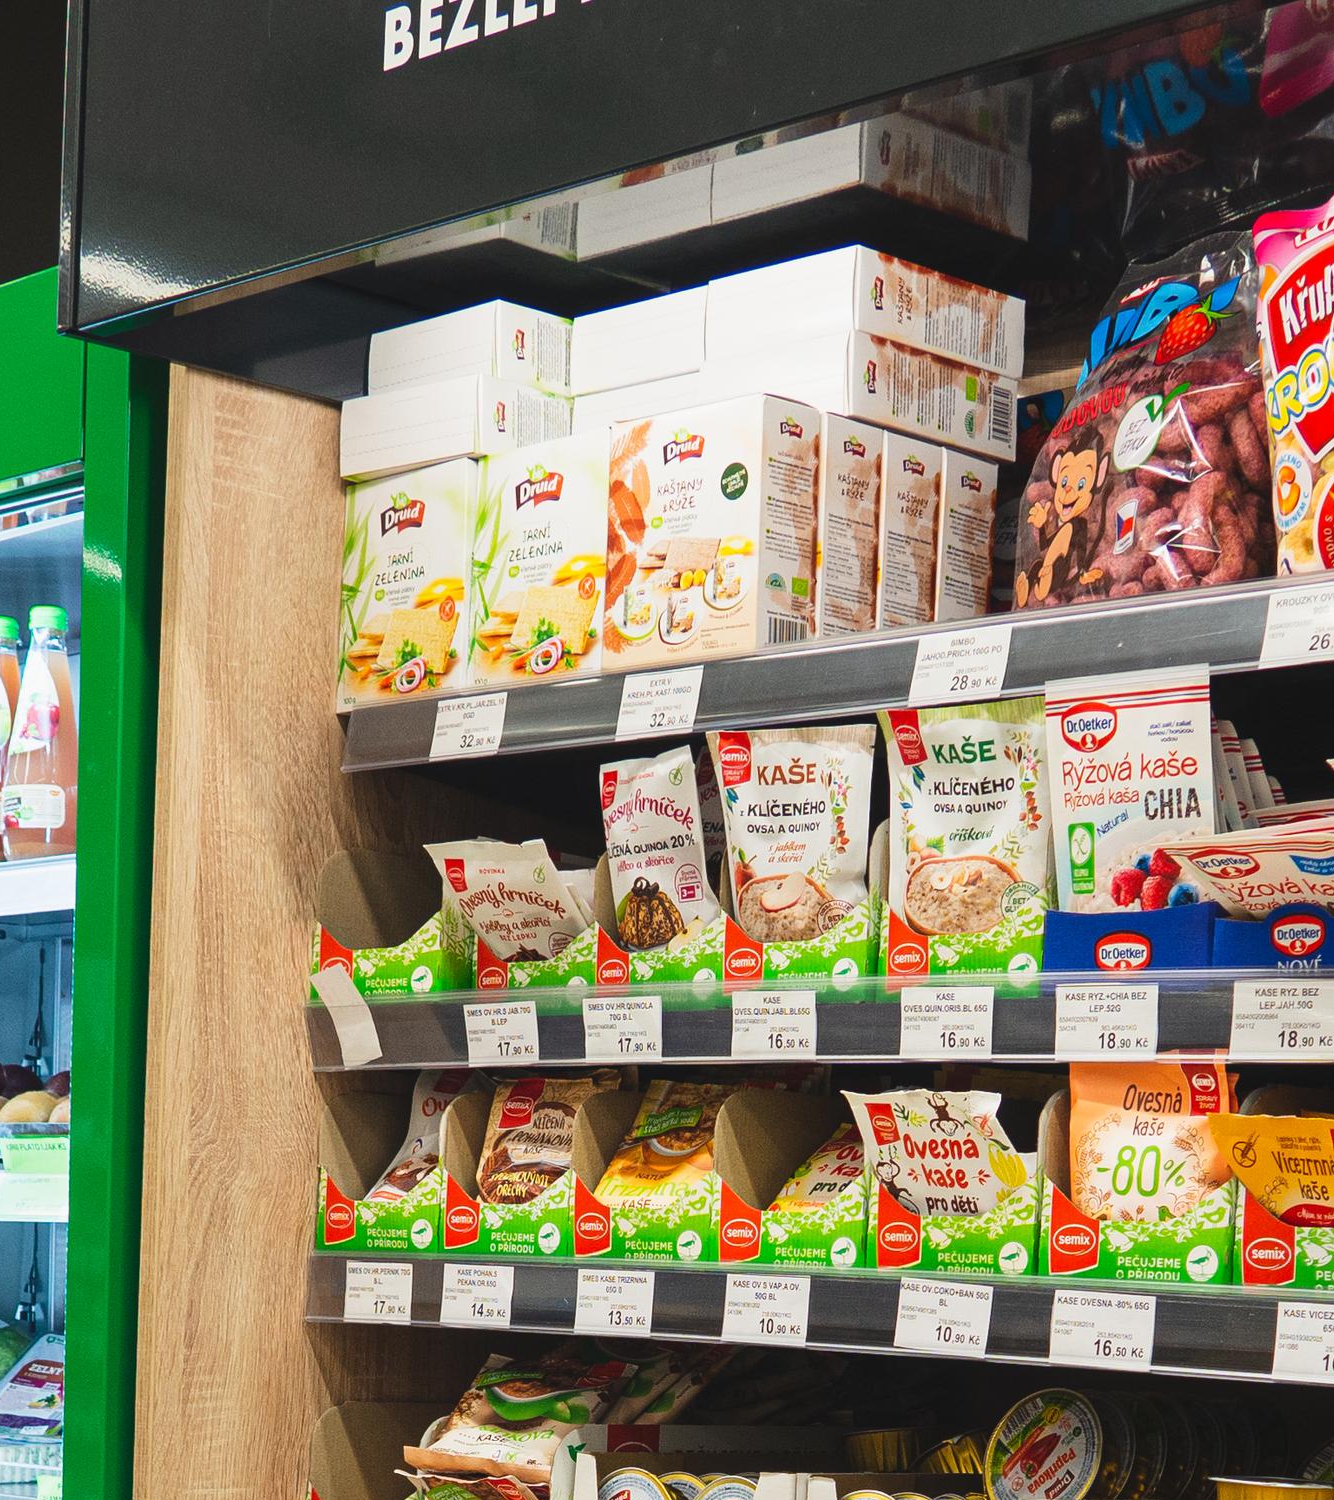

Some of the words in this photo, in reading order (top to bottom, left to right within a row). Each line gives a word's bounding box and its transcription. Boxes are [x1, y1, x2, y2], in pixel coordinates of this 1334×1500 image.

[521, 476, 559, 503] Druid
[1066, 716, 1112, 734] Dr.Oetker
[932, 739, 997, 765] KAŠE
[756, 761, 816, 787] KAŠE
[1062, 761, 1135, 789] Rýžová
[1141, 756, 1198, 780] kaše
[934, 776, 1015, 798] KLÍČENÉHO
[748, 798, 827, 818] KLÍČENÉHO
[1144, 786, 1202, 820] CHIA
[783, 821, 821, 833] QUINOY
[727, 954, 760, 971] semix
[941, 1031, 971, 1048] 16,90
[973, 1033, 985, 1044] Kč
[1123, 1083, 1183, 1116] Ovesná
[1131, 1116, 1165, 1138] kaše
[904, 1135, 979, 1163] Ovesná
[923, 1163, 969, 1190] kaše
[1097, 1144, 1186, 1198] -80%
[927, 1197, 948, 1214] pro
[951, 1195, 979, 1213] děti
[936, 1325, 965, 1343] 10,90
[968, 1330, 980, 1343] Kč
